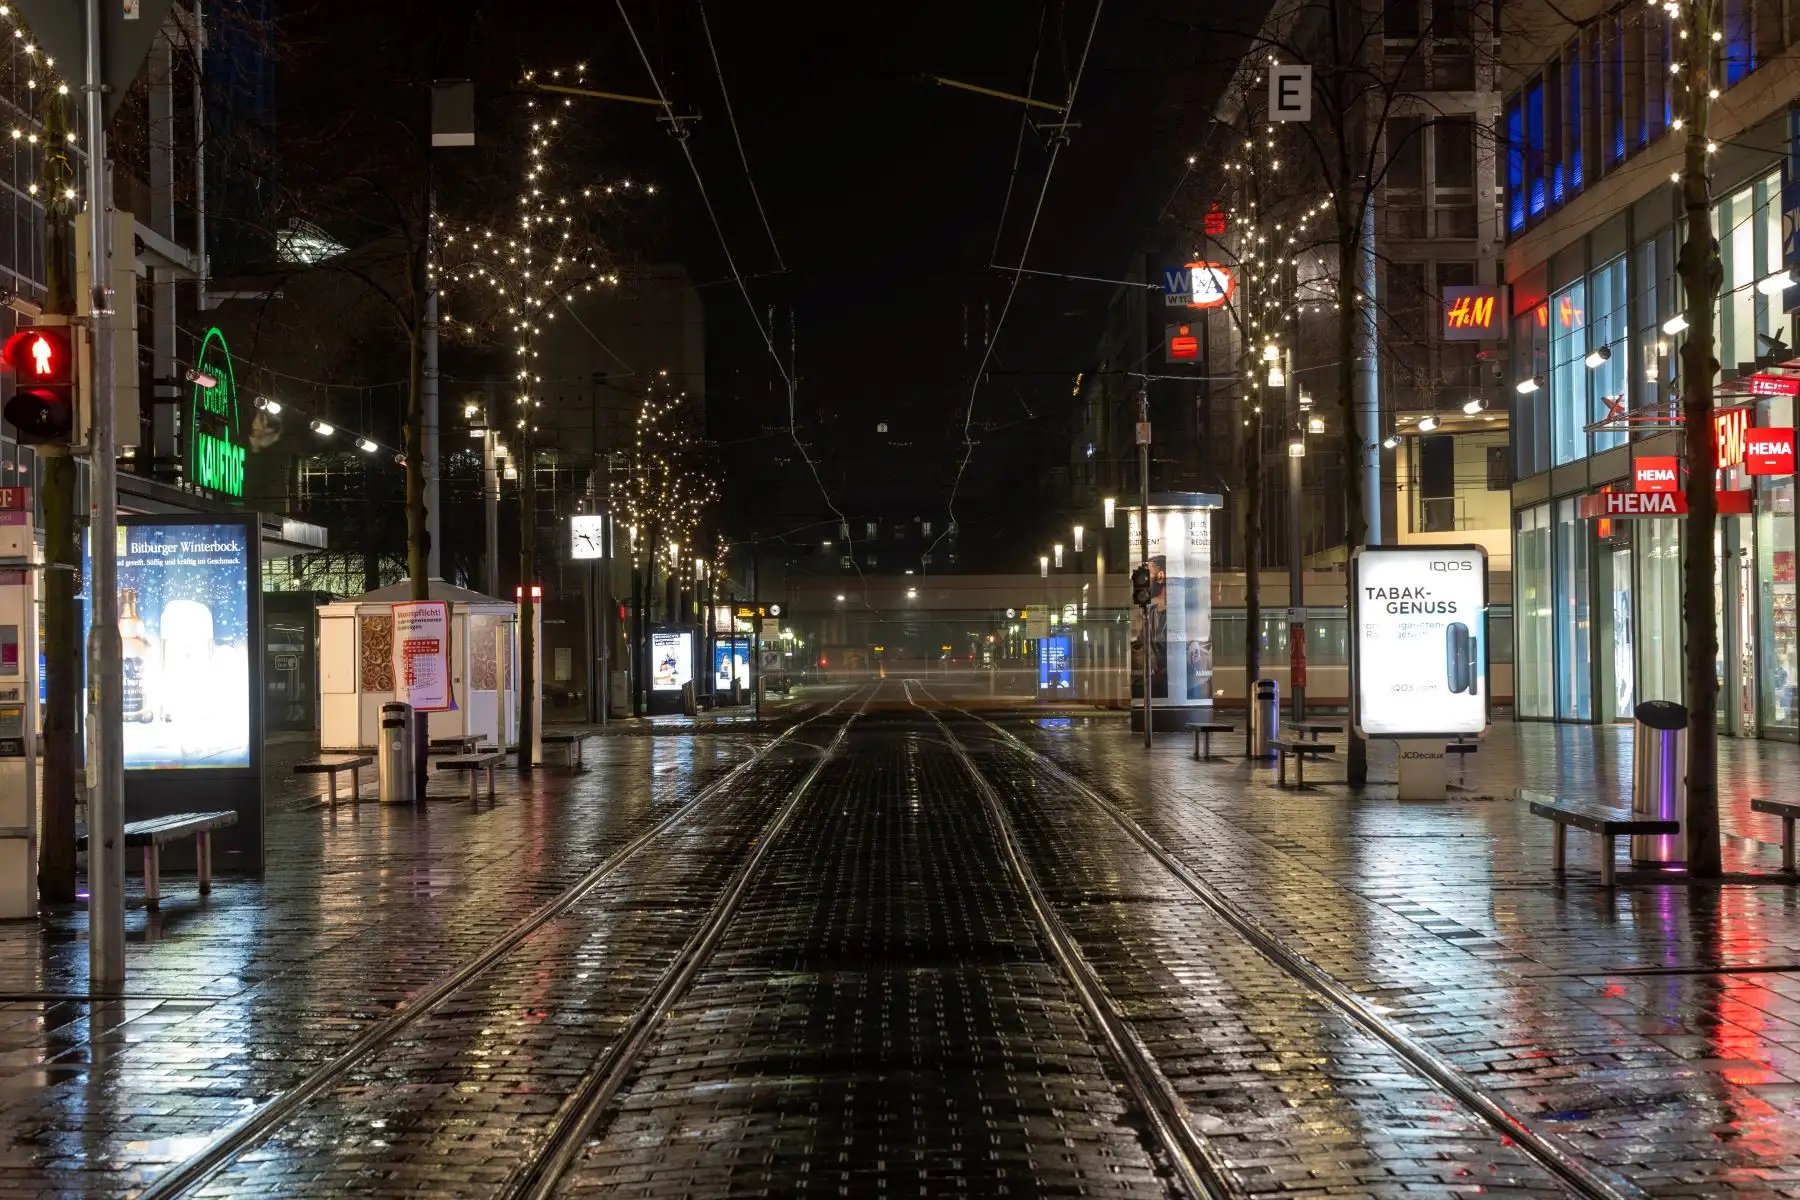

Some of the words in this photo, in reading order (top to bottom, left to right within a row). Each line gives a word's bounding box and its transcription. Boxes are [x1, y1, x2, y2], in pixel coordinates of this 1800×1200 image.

[1278, 75, 1301, 110] E
[1448, 297, 1494, 328] H&M
[1714, 409, 1747, 468] EMA
[1749, 442, 1792, 455] HEMA
[1637, 469, 1675, 481] HEMA
[1607, 493, 1677, 513] HEMA
[131, 542, 178, 556] Bitburger
[180, 540, 241, 553] Winterbock.
[165, 557, 176, 566] und
[1429, 561, 1473, 573] IQOS
[1365, 586, 1432, 600] TABAK-
[1386, 601, 1457, 614] GENUSS
[1401, 751, 1444, 760] JCDecaux
